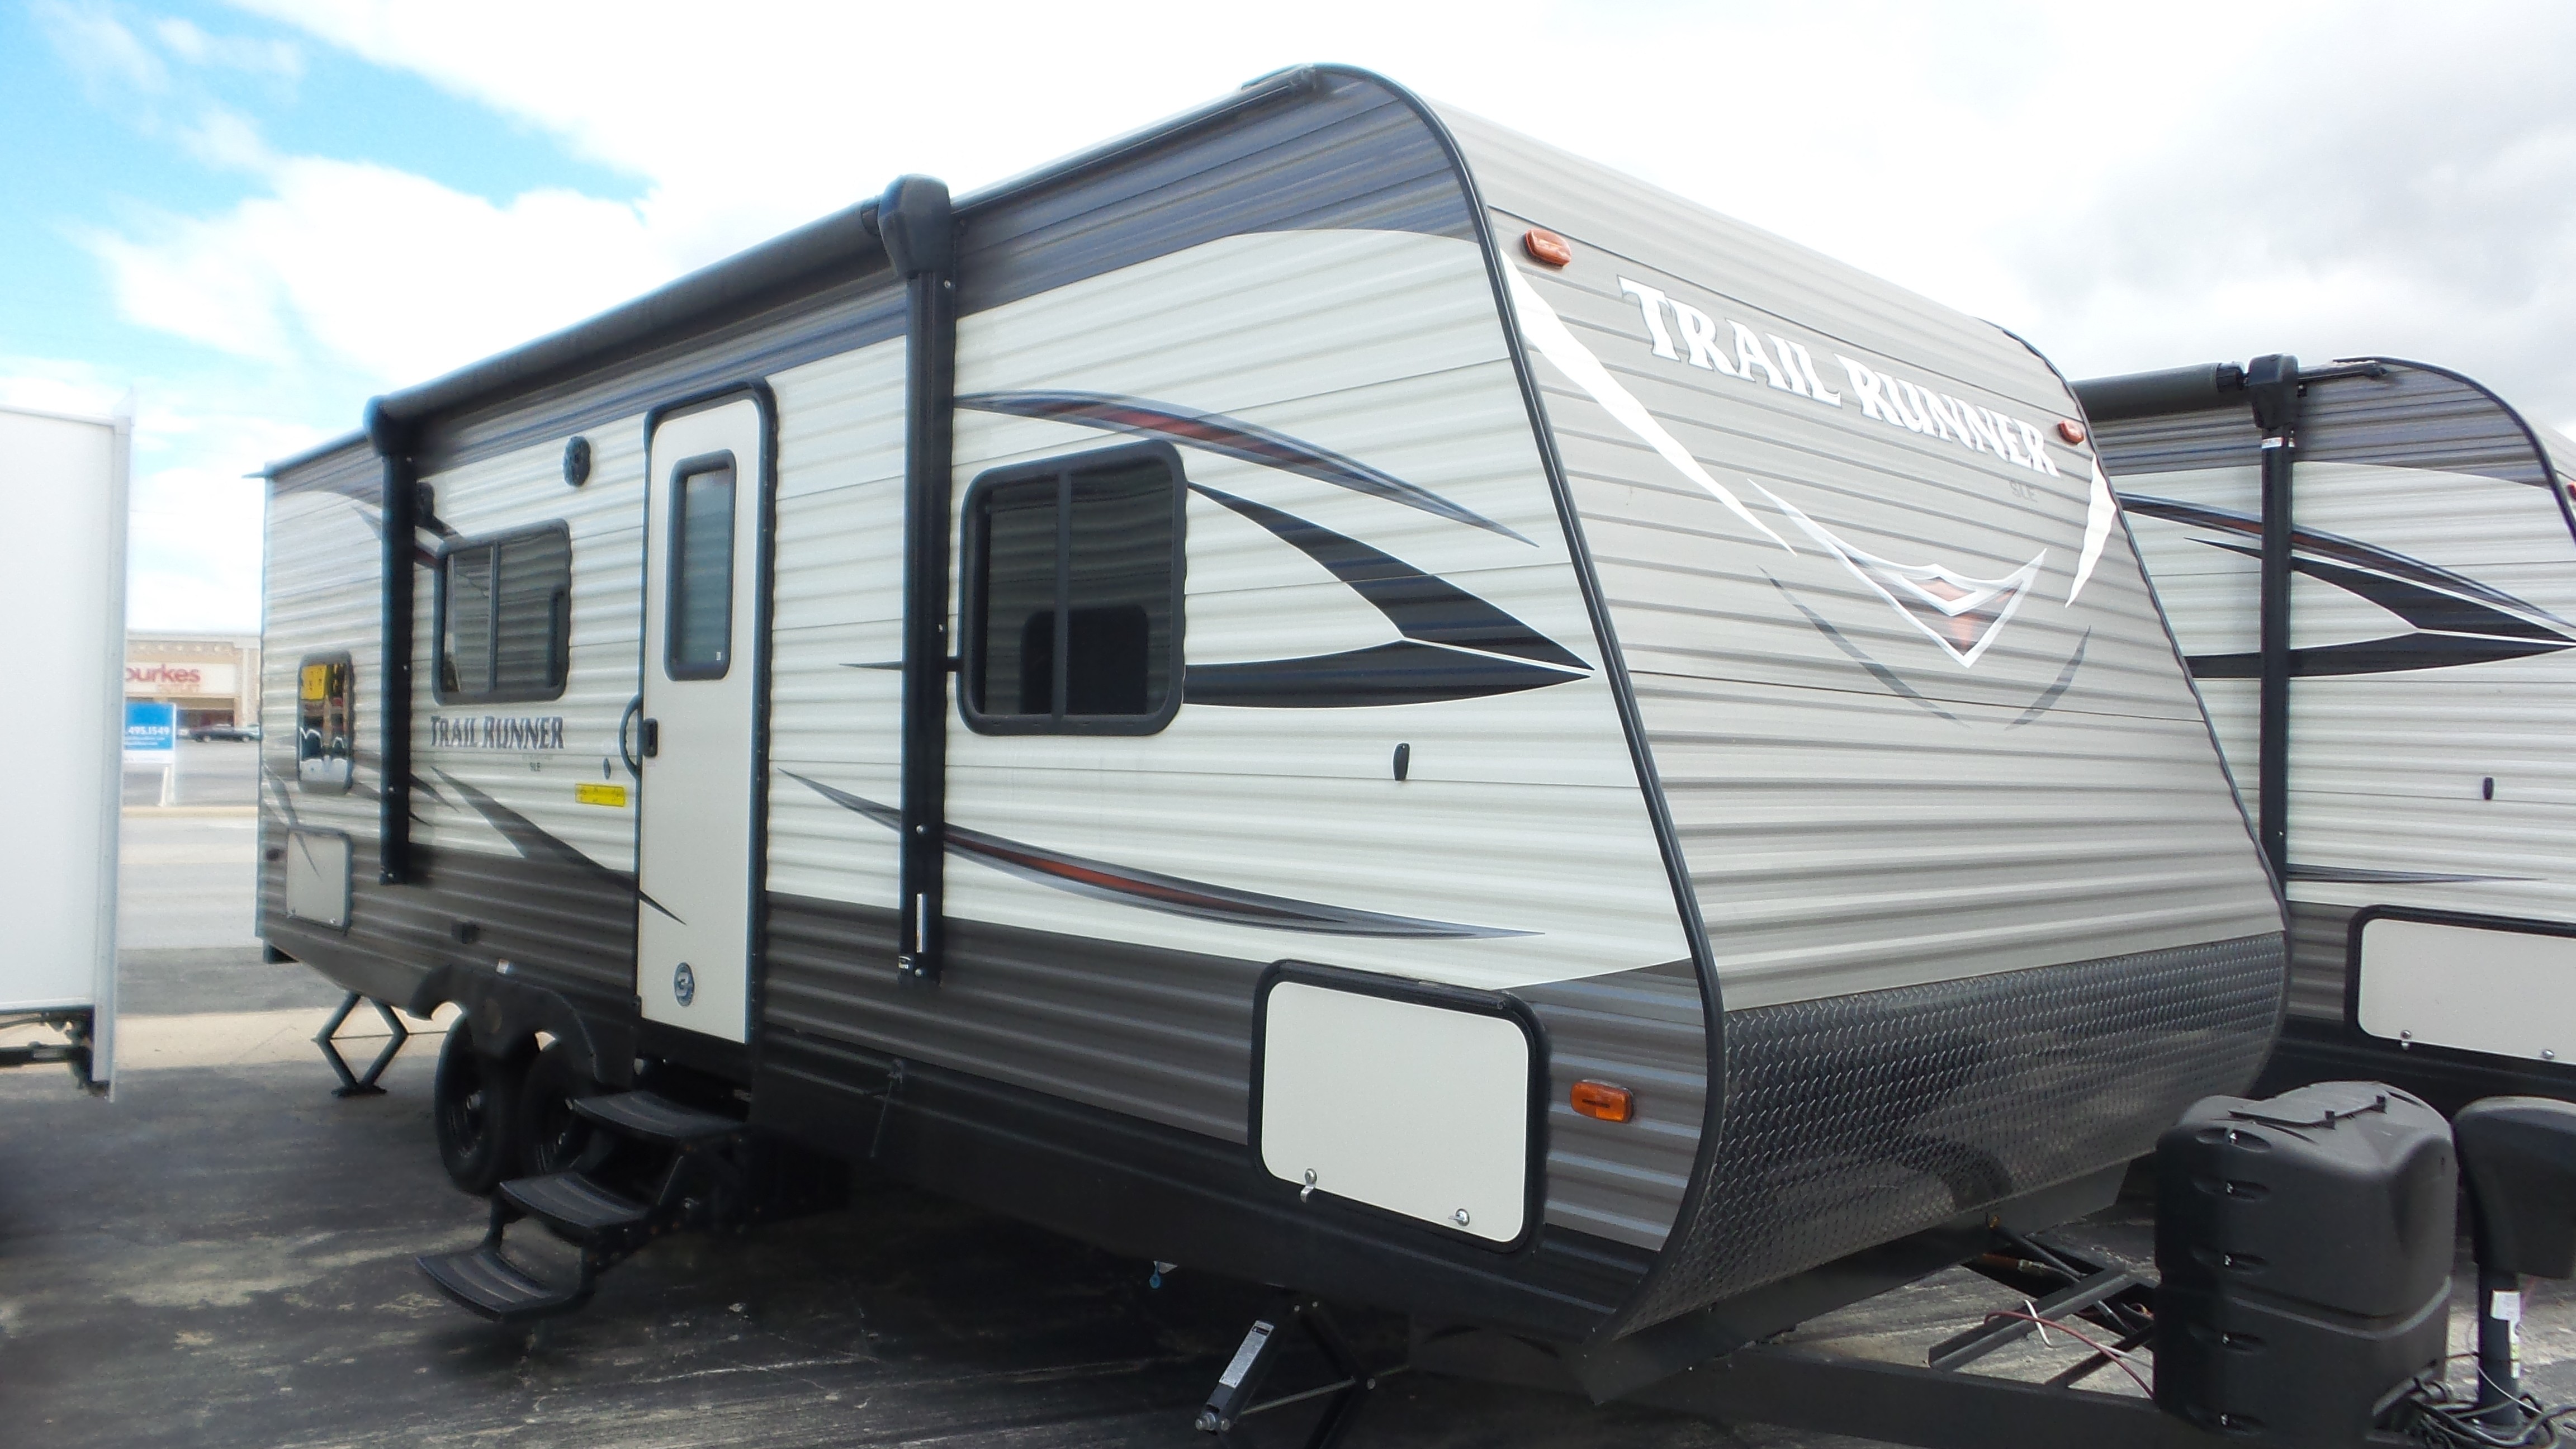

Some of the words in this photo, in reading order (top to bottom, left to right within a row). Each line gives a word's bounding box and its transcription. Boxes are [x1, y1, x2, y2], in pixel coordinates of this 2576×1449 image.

[1617, 274, 1843, 409] TRAIL
[1833, 353, 2062, 479] RUNNER
[430, 715, 477, 747] TRAIL
[482, 715, 564, 750] RUNNER
